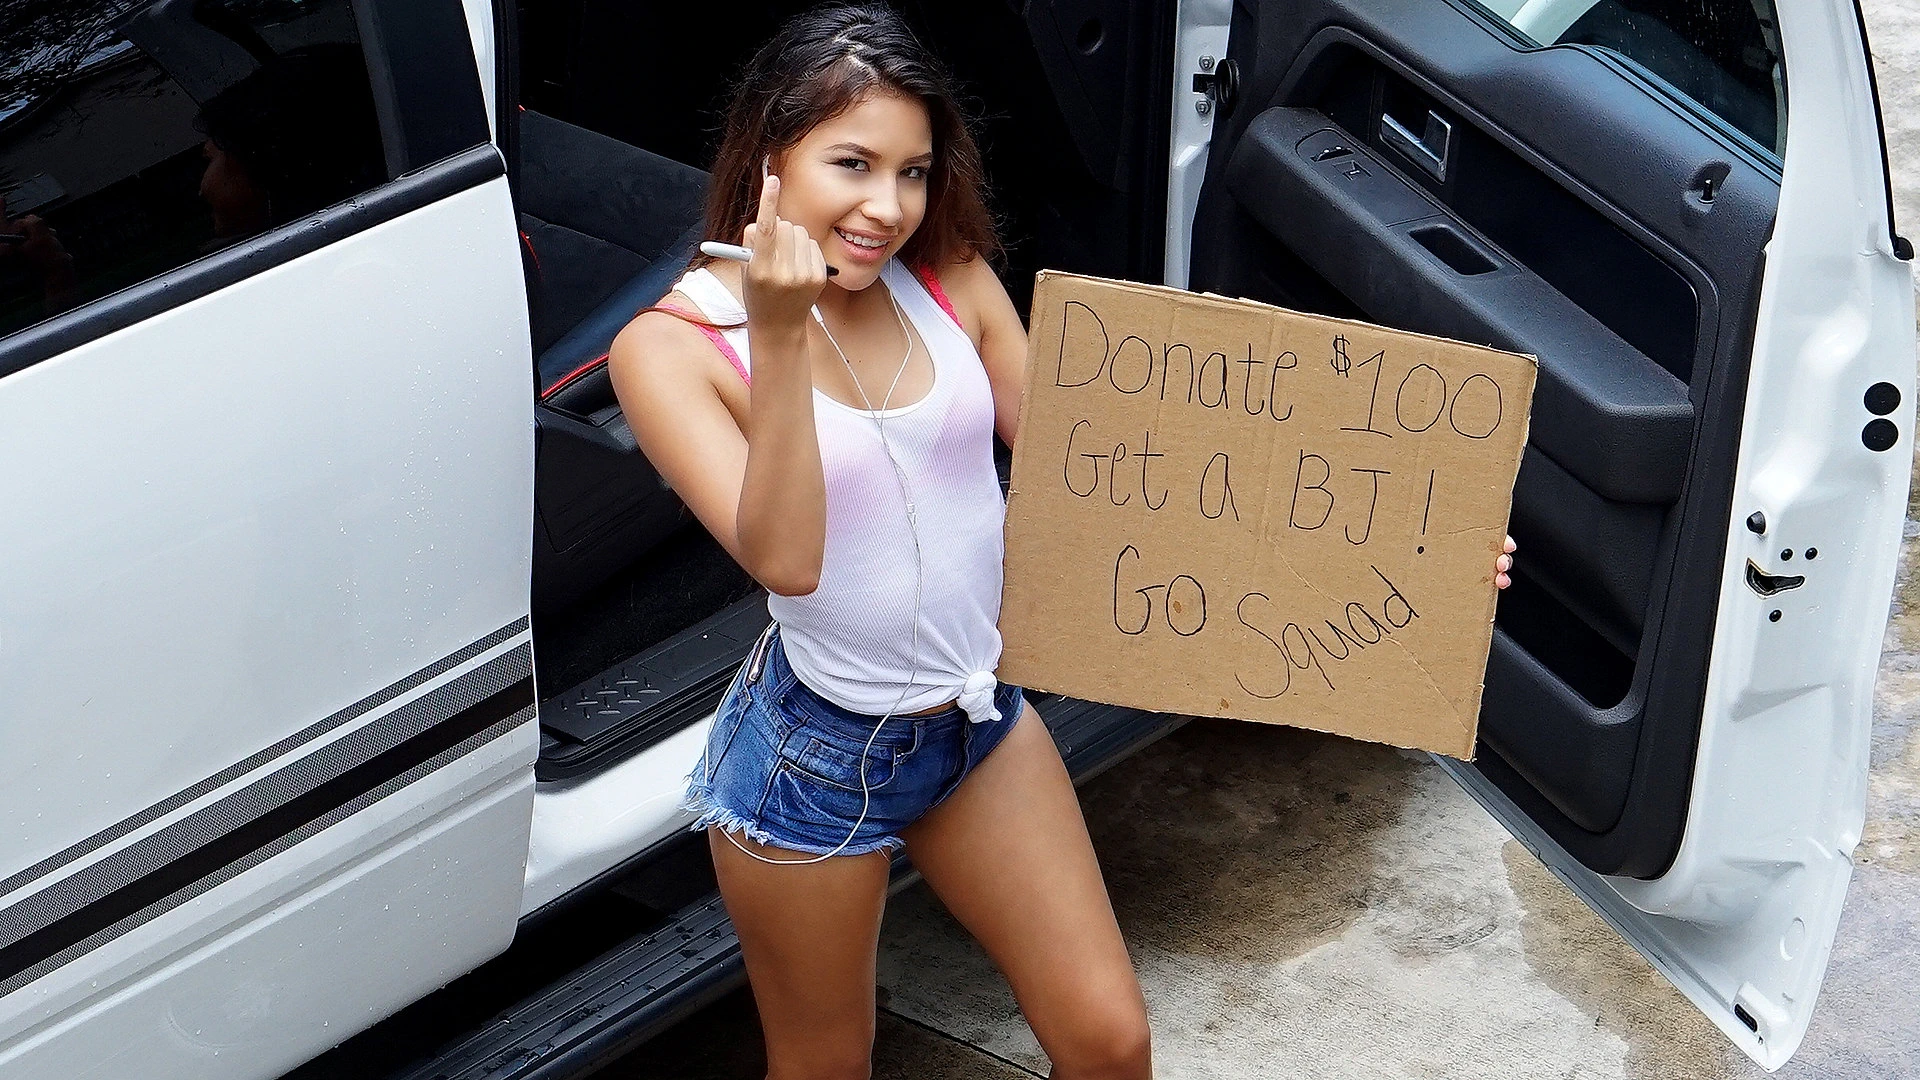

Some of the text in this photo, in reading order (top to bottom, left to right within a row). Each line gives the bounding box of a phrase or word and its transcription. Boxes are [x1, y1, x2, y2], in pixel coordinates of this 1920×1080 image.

[1056, 300, 1503, 439] Donate $100
[1063, 419, 1169, 511] Get
[1199, 452, 1240, 522] a
[1234, 564, 1420, 699] Squad
